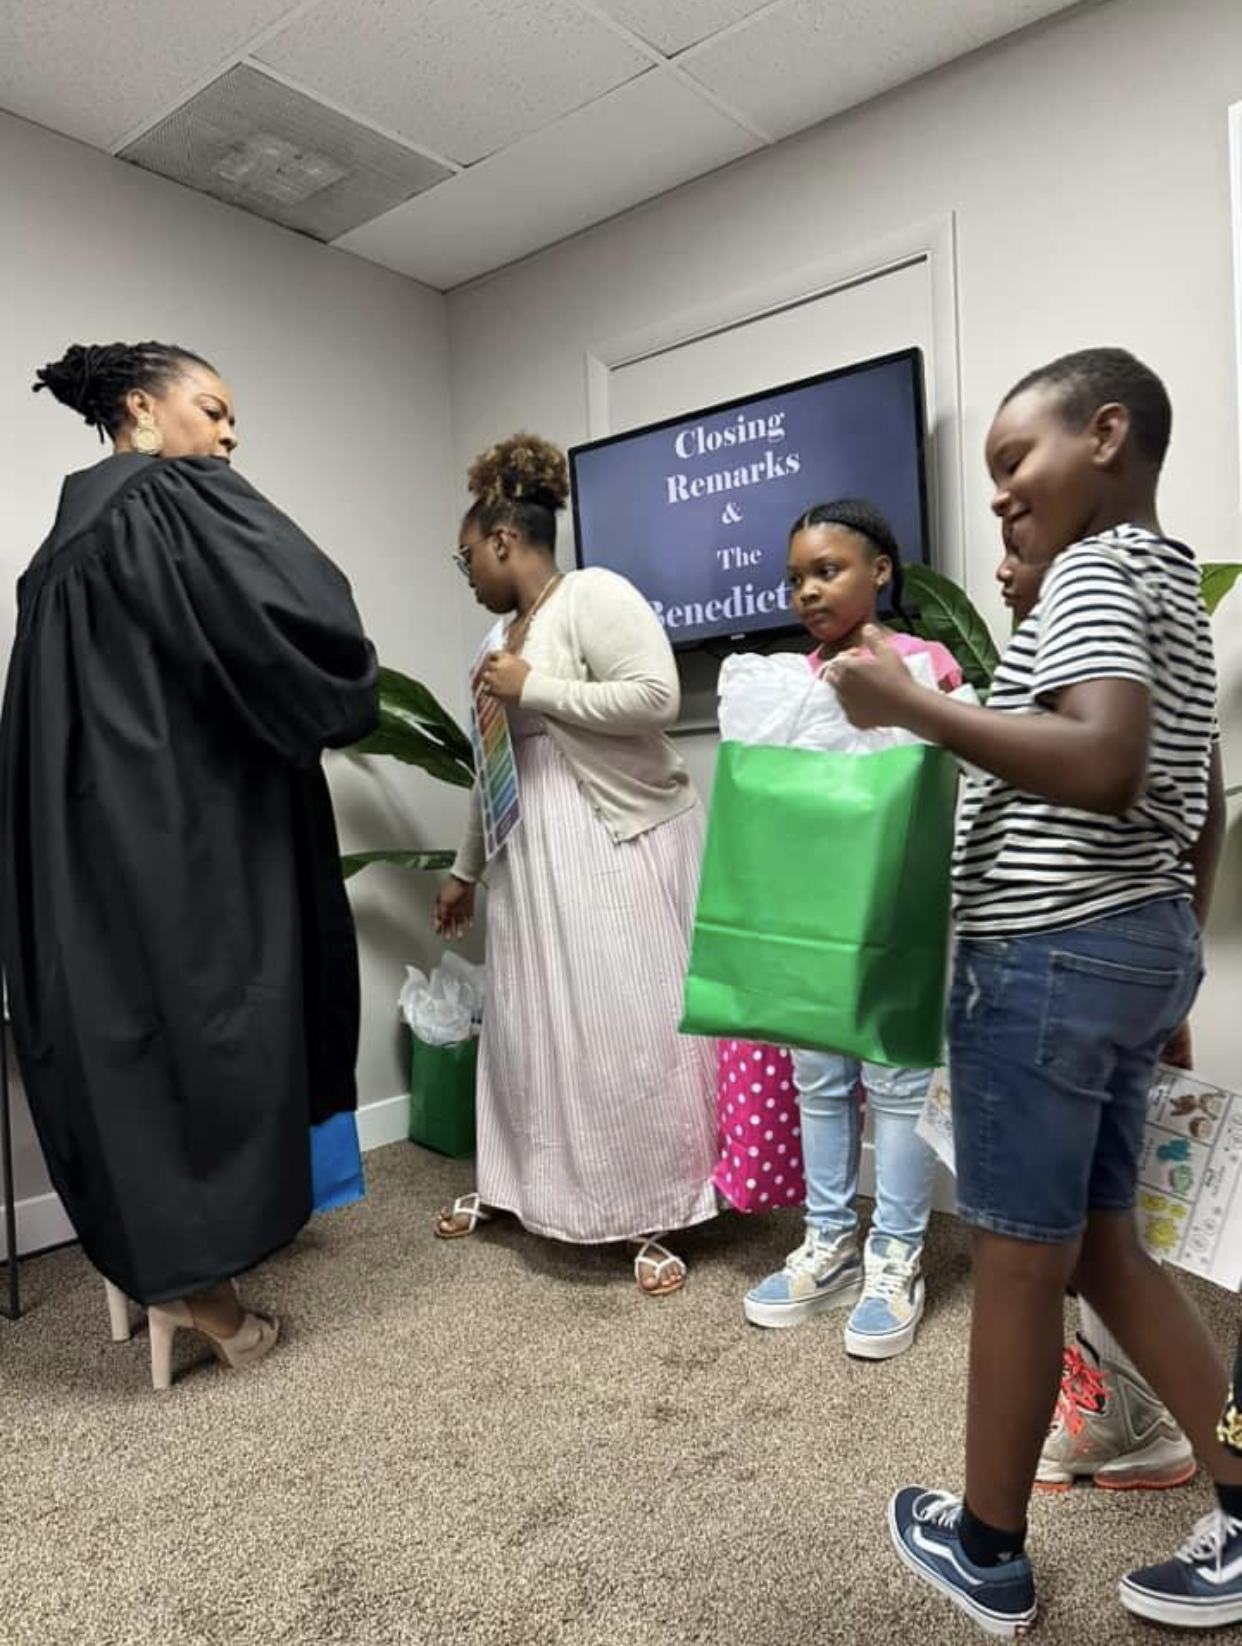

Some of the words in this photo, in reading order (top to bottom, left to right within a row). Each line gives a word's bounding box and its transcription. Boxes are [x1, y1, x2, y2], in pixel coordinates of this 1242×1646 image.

[675, 412, 785, 459] Closing
[667, 450, 801, 503] Remarks
[721, 502, 743, 524] &
[717, 546, 762, 570] The
